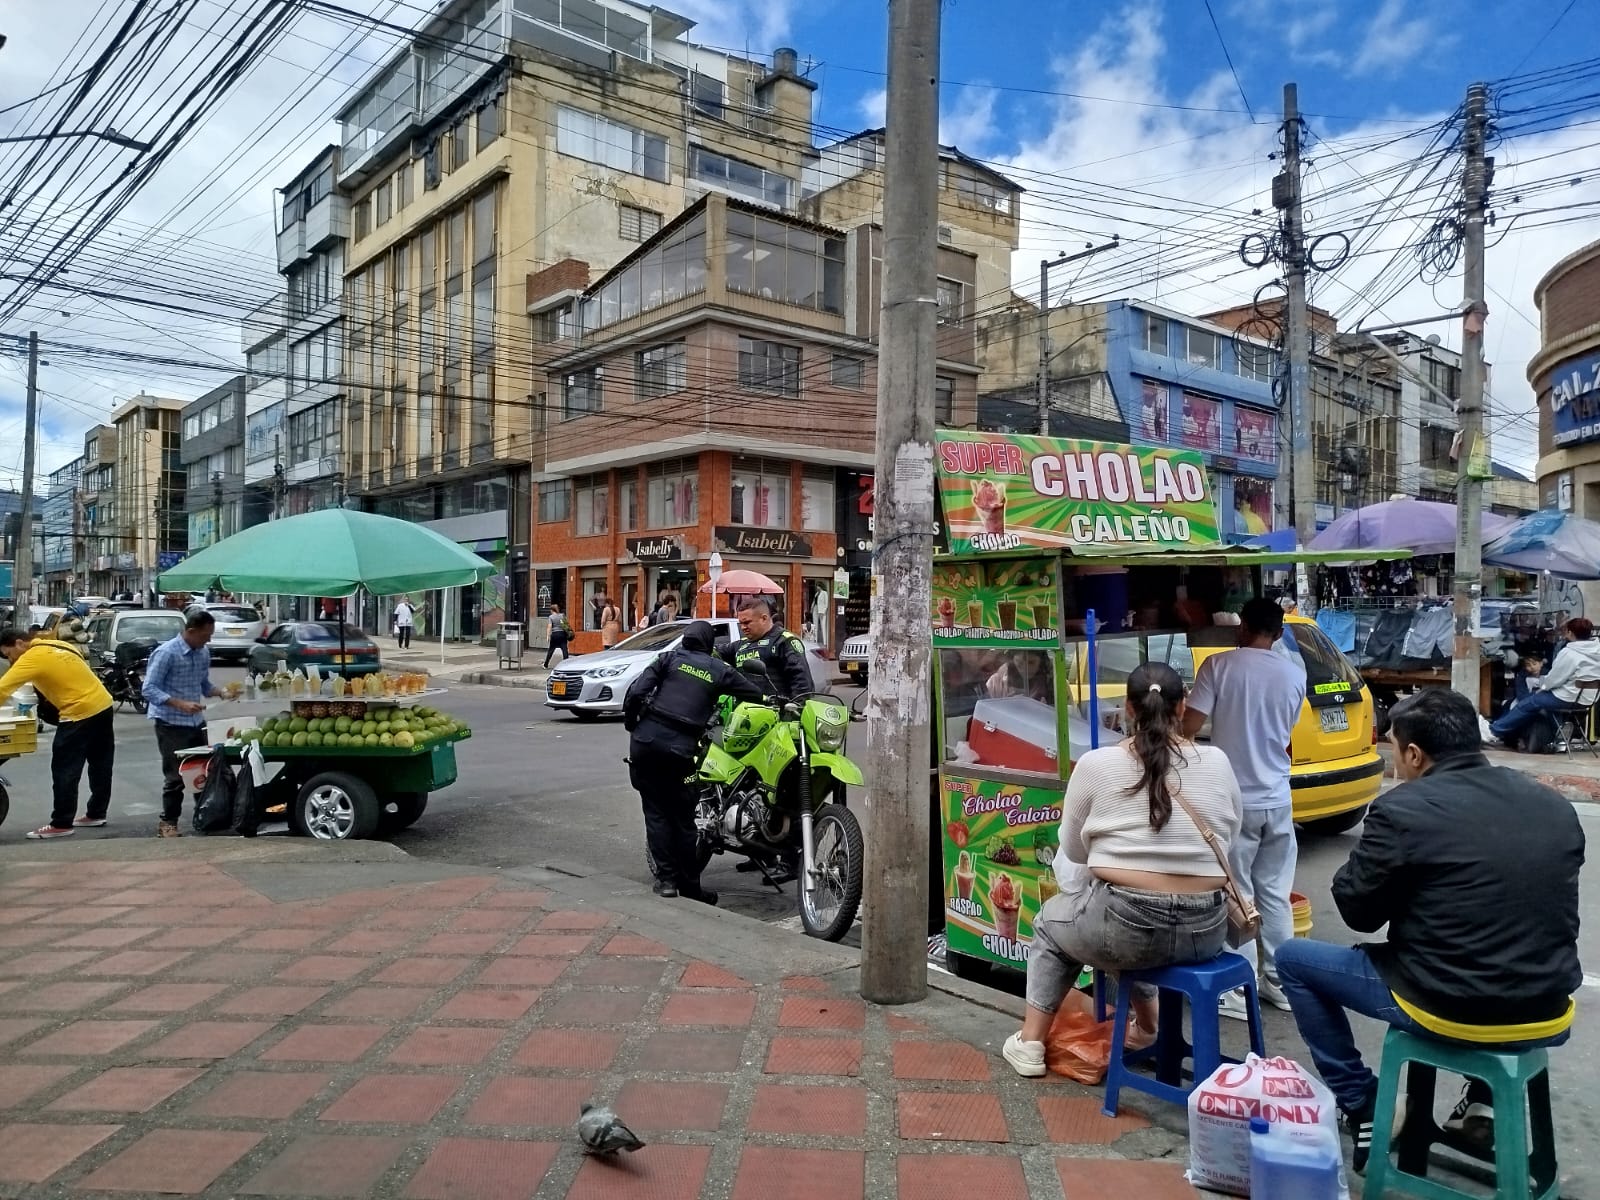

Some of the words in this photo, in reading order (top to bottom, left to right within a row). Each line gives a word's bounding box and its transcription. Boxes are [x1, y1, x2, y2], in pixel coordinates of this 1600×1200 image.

[940, 440, 1026, 475] SUPER
[1030, 452, 1205, 503] CHOLAO
[1070, 508, 1191, 542] CALEÑO
[636, 539, 674, 559] Isabelly
[736, 531, 797, 555] Isabelly
[970, 533, 1021, 550] CHOLAO
[934, 627, 962, 638] CHOLAO
[1028, 627, 1057, 640] LULADA
[944, 780, 973, 794] SUPER
[963, 791, 1022, 816] Cholao
[1004, 805, 1062, 826] Caleño
[950, 897, 982, 917] RASPAO
[1200, 1095, 1257, 1119] ONLY
[1262, 1104, 1320, 1124] ONLY
